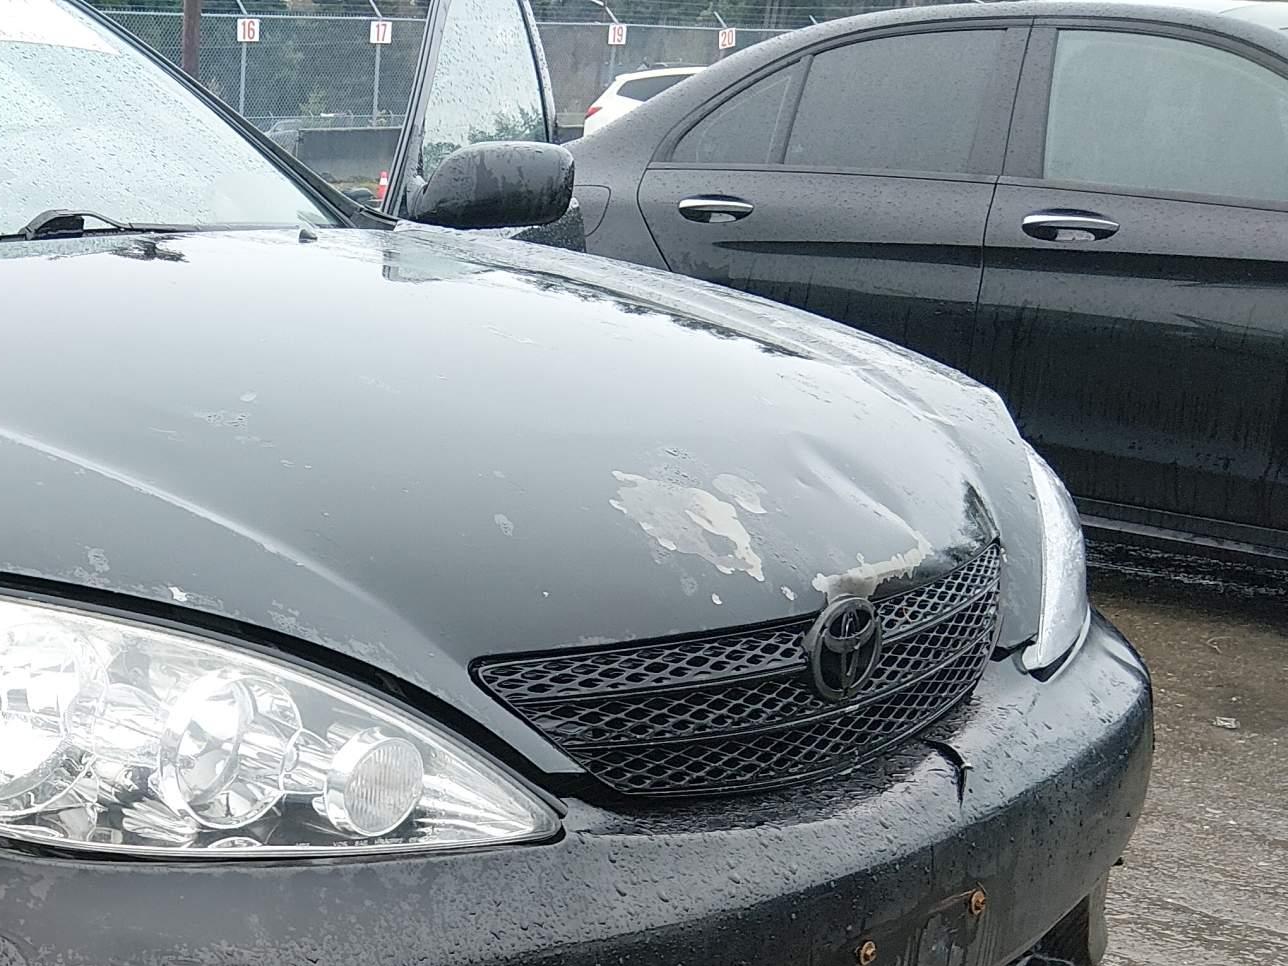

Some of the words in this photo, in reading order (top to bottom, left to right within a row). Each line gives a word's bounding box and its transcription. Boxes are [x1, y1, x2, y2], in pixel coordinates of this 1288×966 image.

[241, 20, 256, 40] 16
[375, 23, 388, 42] 17
[612, 26, 624, 43] 19
[721, 31, 734, 47] 20
